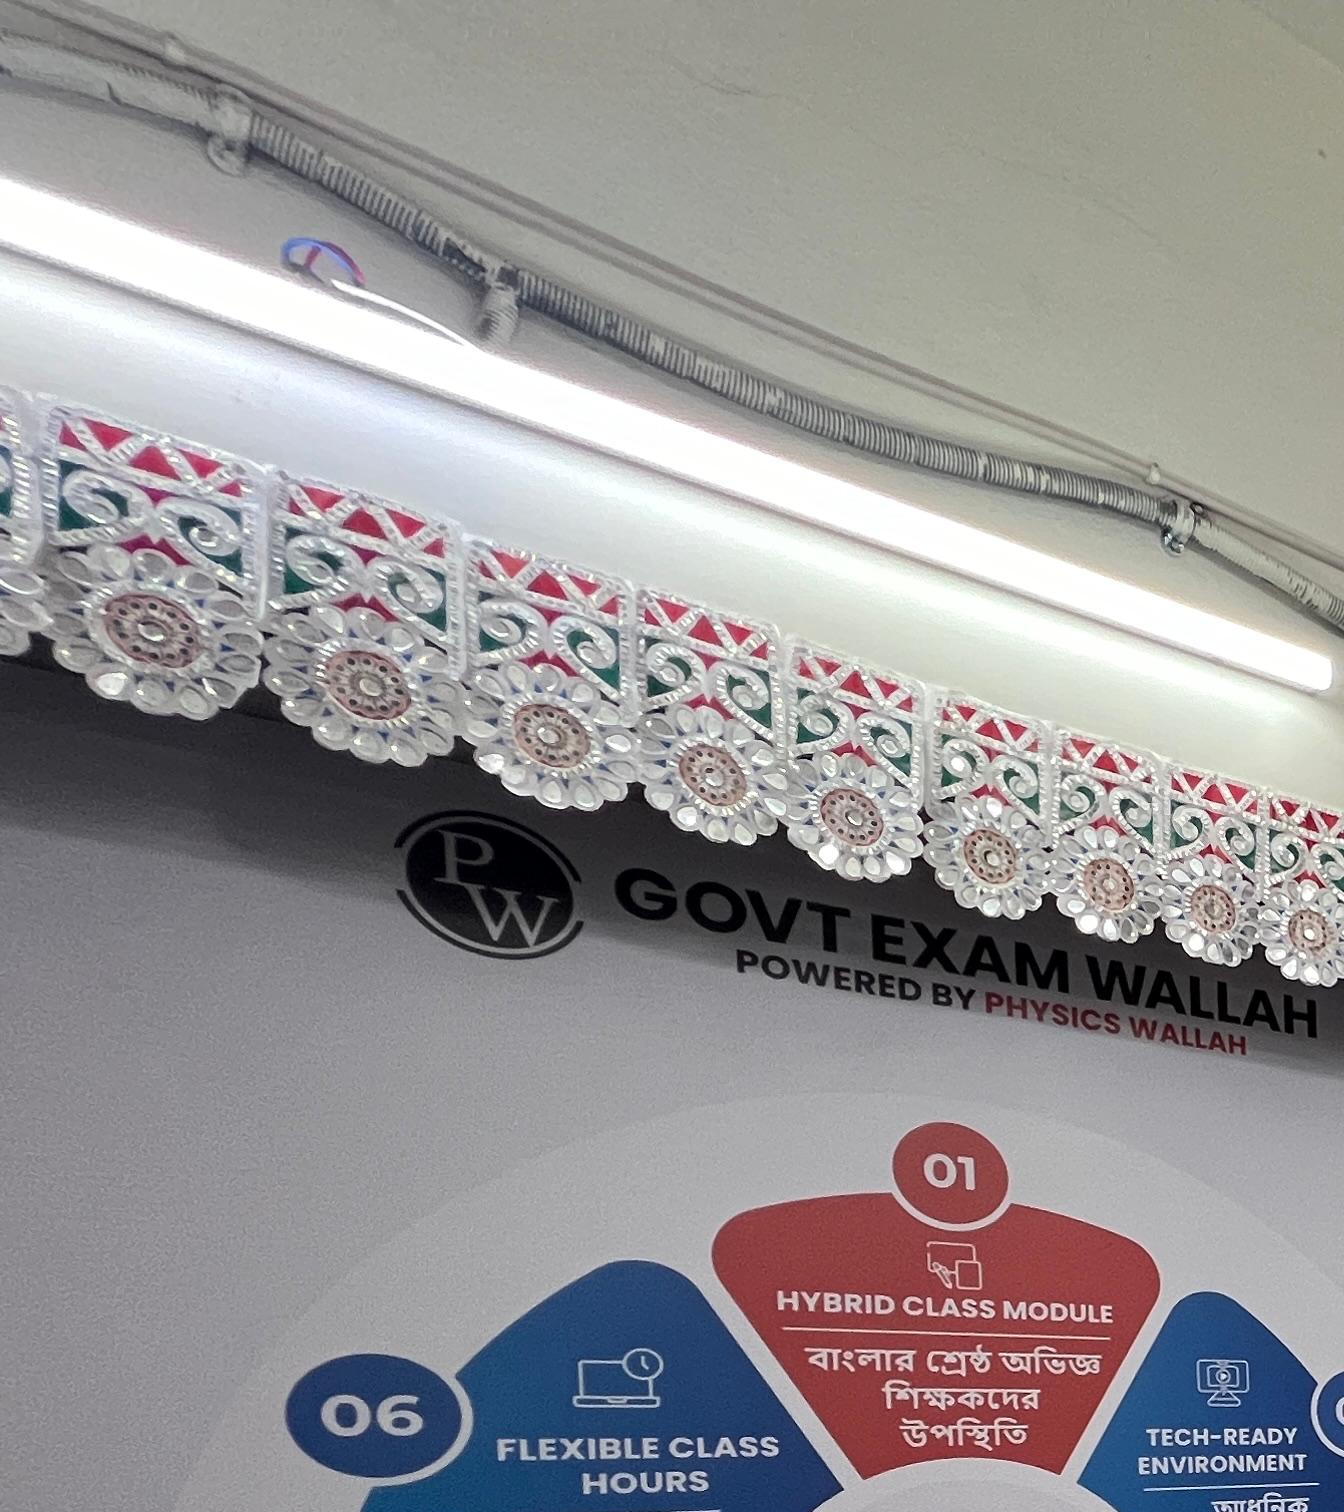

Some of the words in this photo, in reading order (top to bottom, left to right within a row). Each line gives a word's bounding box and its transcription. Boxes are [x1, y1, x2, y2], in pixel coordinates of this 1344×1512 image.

[613, 867, 852, 953] GOVT
[870, 917, 1070, 993] EXAM
[1086, 955, 1318, 1038] WALLAH
[736, 949, 922, 1001] POWERED
[931, 983, 978, 1012] BY
[984, 991, 1121, 1034] PHYSICS
[1129, 1015, 1247, 1056] WALLAH
[922, 1152, 977, 1191] 01
[776, 1290, 896, 1315] HYBRID
[902, 1296, 996, 1319] CLASS
[1002, 1300, 1114, 1324] MODULE
[804, 1346, 915, 1374] বাংলার
[926, 1344, 993, 1377] শ্রেষ্ঠ
[998, 1346, 1103, 1376] অভিজ্ঞ
[882, 1379, 1041, 1411] শিক্ষকদের
[319, 1394, 425, 1438] 06
[496, 1436, 660, 1462] FLEXIBLE
[667, 1435, 780, 1459] CLASS
[900, 1416, 1028, 1452] উপস্থিতি
[1145, 1426, 1298, 1447] TECH-READY
[1137, 1453, 1308, 1476] ENVIRONMENT
[581, 1470, 710, 1495] HOURS
